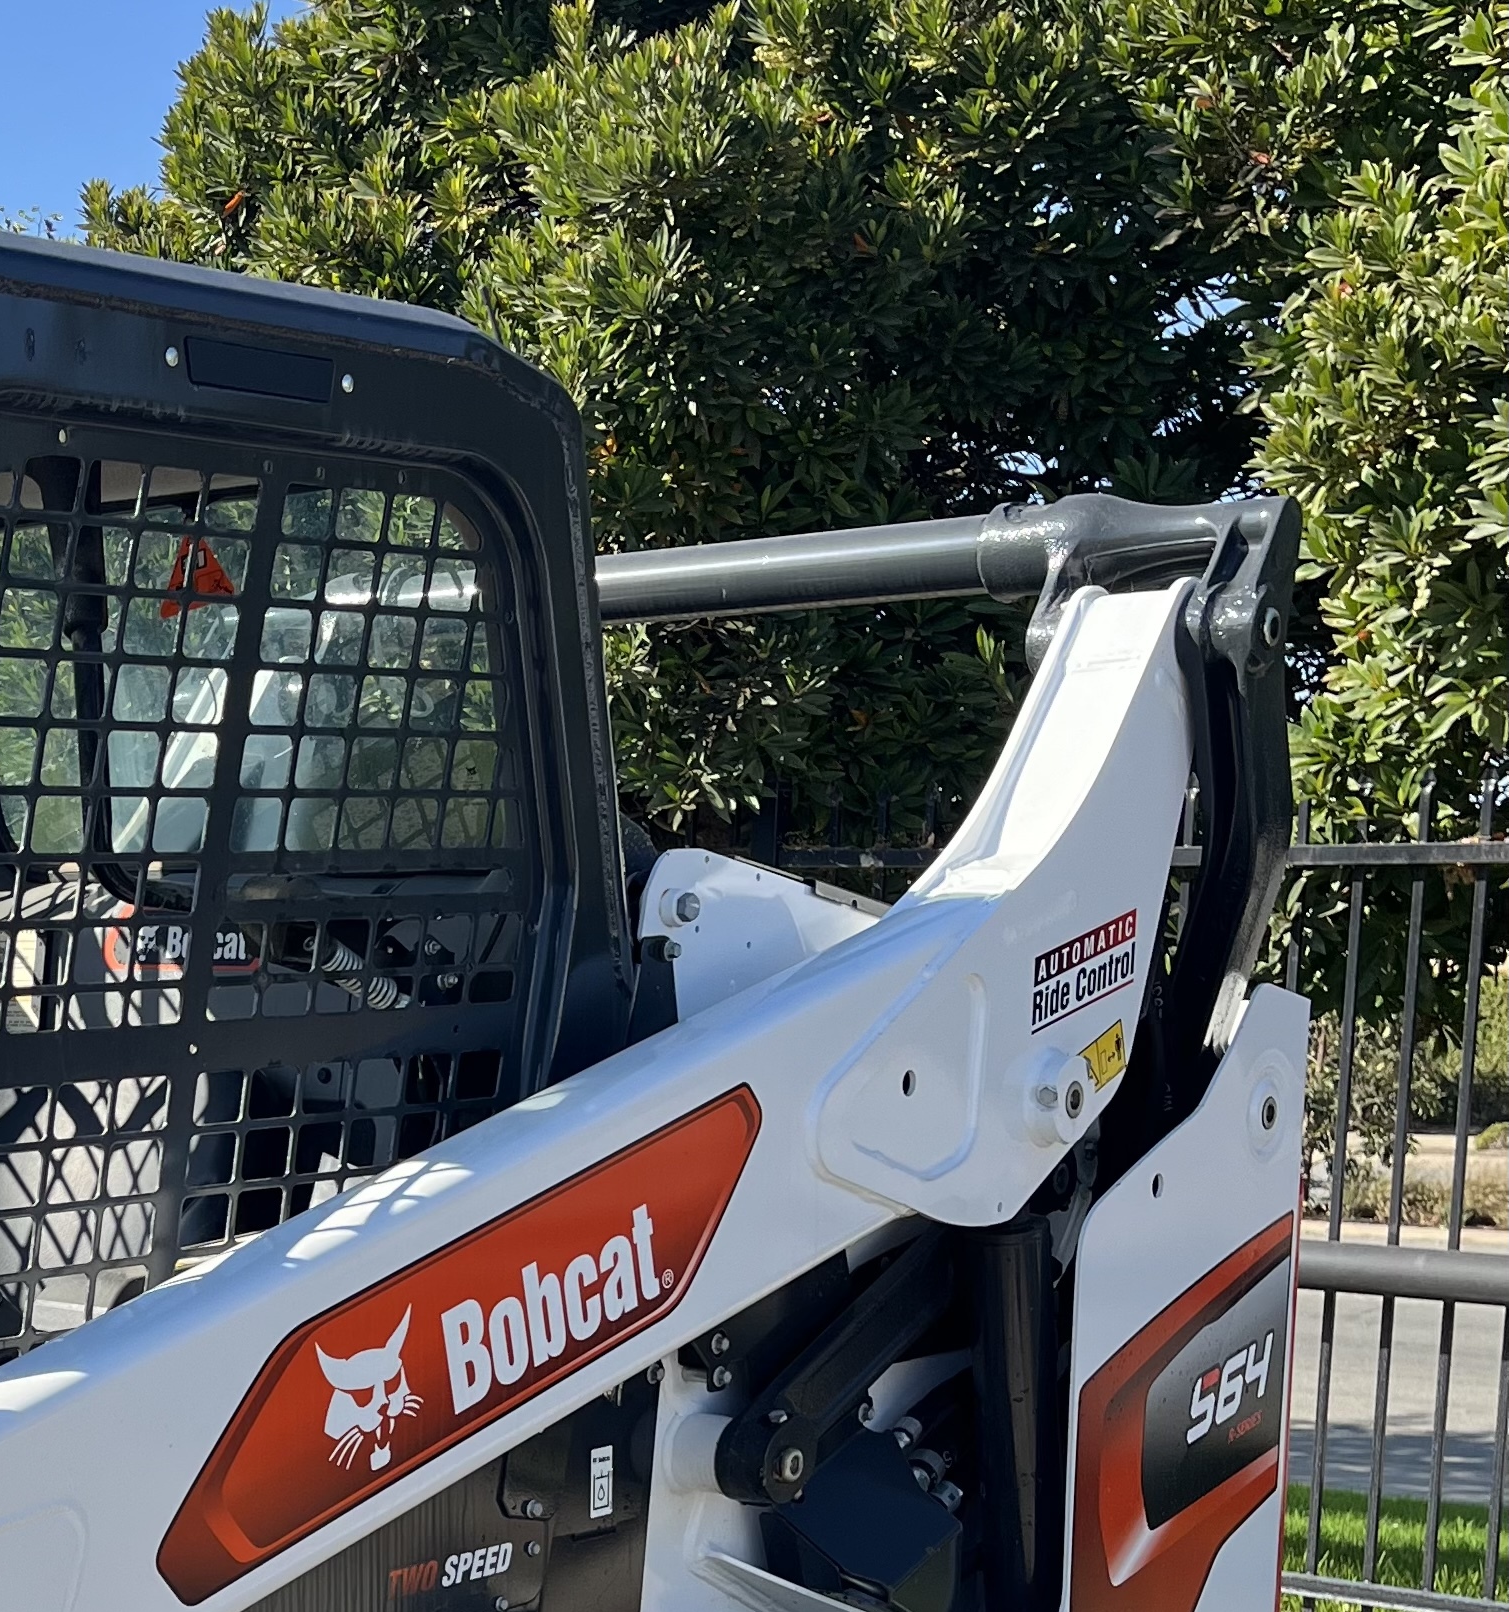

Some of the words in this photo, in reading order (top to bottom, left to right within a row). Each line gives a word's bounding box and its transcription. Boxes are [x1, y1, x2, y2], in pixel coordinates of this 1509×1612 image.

[1031, 979, 1070, 1026] Ride
[1075, 941, 1136, 1002] Control
[1037, 915, 1133, 982] AUTOMATIC
[1186, 1331, 1274, 1445] S64
[390, 1560, 438, 1598] TWO
[441, 1542, 513, 1588] SPEED
